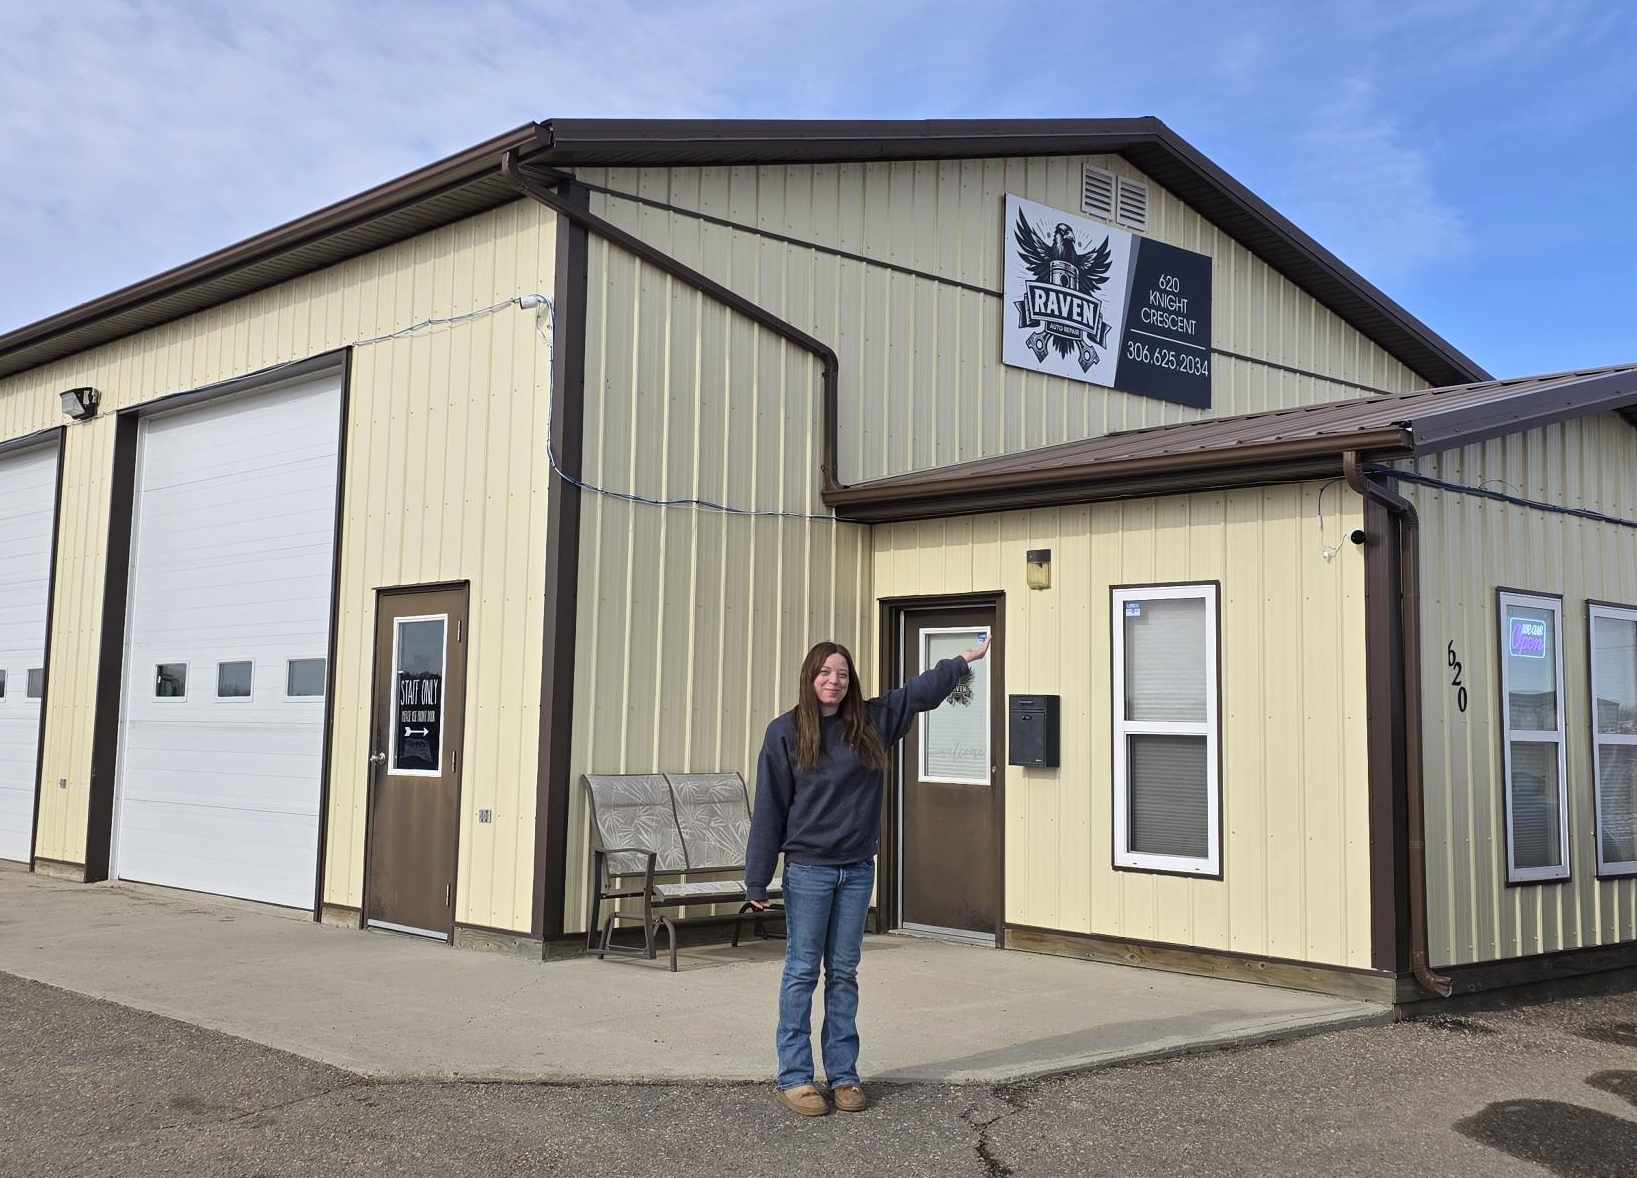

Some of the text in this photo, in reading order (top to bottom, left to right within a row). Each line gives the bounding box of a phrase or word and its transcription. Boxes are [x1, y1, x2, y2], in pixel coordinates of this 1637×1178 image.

[1159, 274, 1180, 293] 620
[1034, 288, 1094, 327] RAVEN
[1149, 289, 1188, 314] KNIGHT
[1050, 323, 1080, 336] AUTO REPAIR
[1141, 307, 1196, 335] CRESCENT
[1127, 340, 1209, 378] 306.625.2034
[1511, 622, 1545, 655] Open
[400, 679, 439, 706] STAFF ONLY
